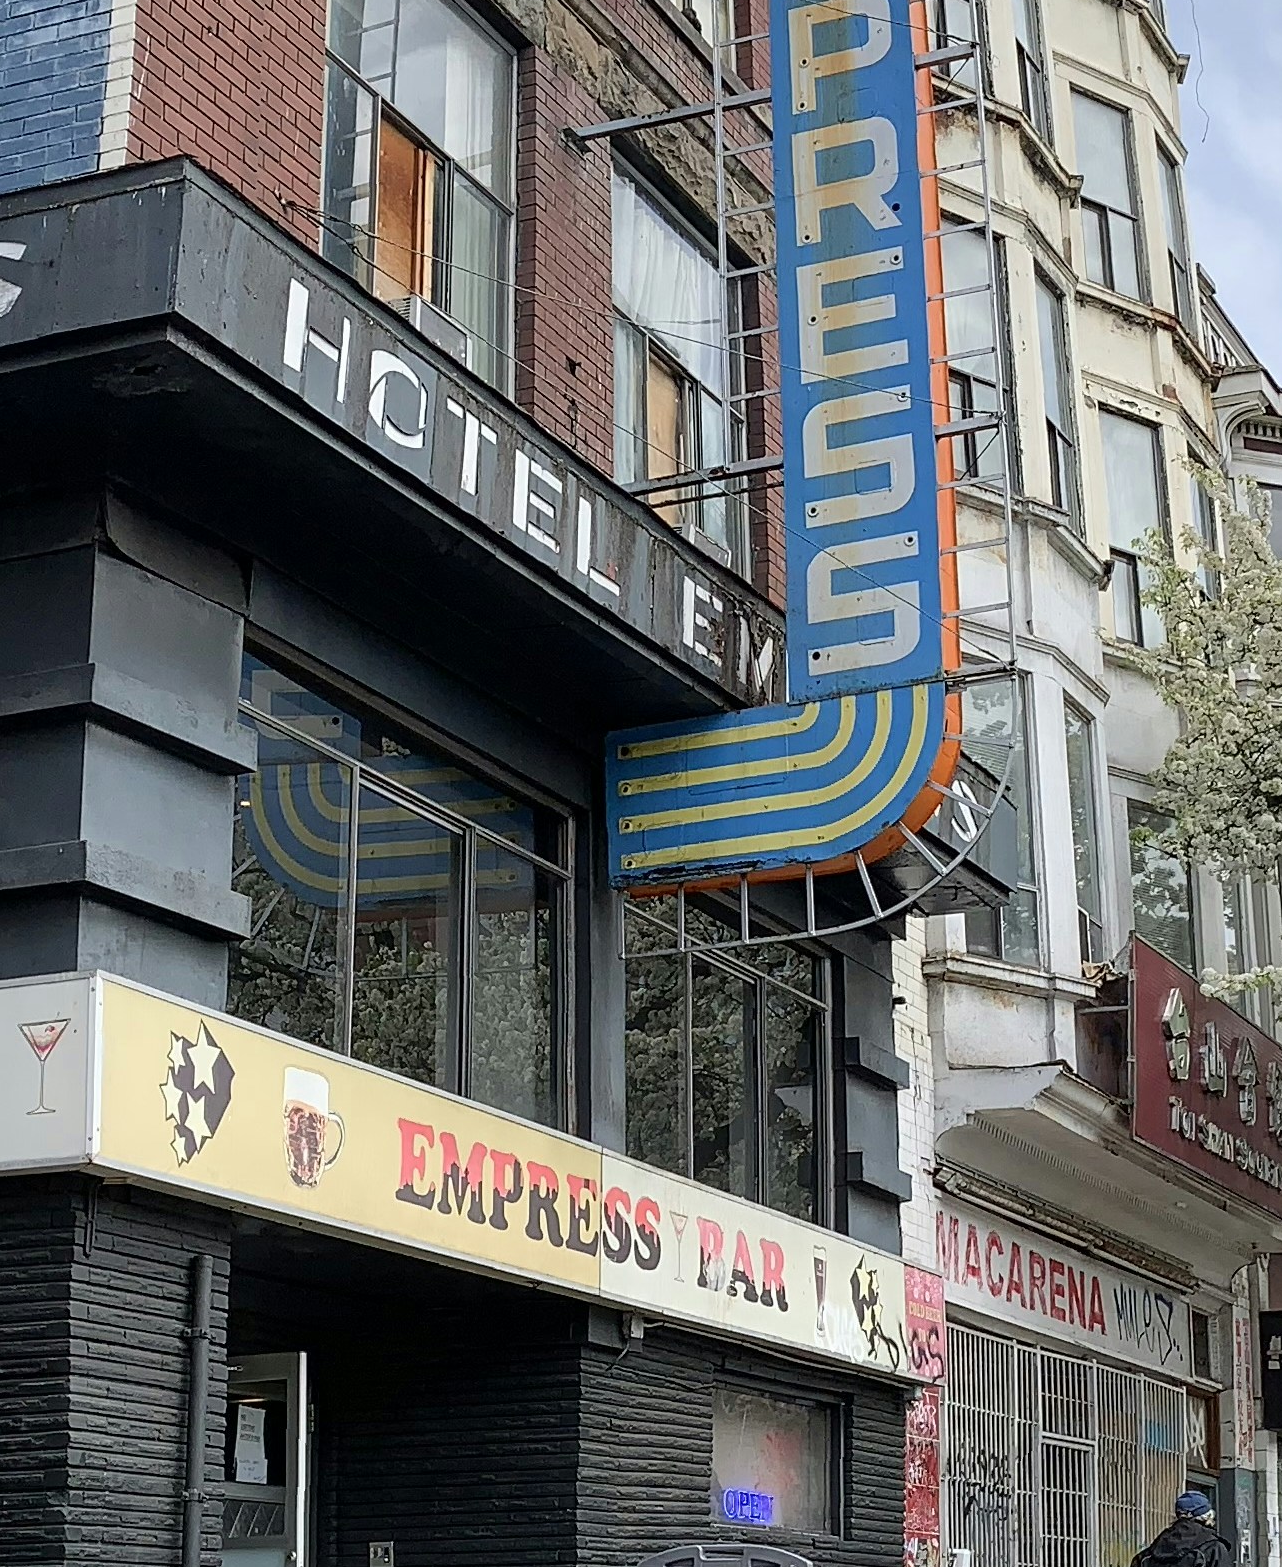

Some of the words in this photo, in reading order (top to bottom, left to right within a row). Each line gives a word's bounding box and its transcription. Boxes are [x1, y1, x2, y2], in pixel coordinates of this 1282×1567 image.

[281, 276, 621, 598] HOTEL
[395, 1116, 664, 1271] EMPRESS
[695, 1215, 791, 1313] BAR
[935, 1210, 1108, 1337] MACARENA
[723, 1487, 774, 1524] OPEN
